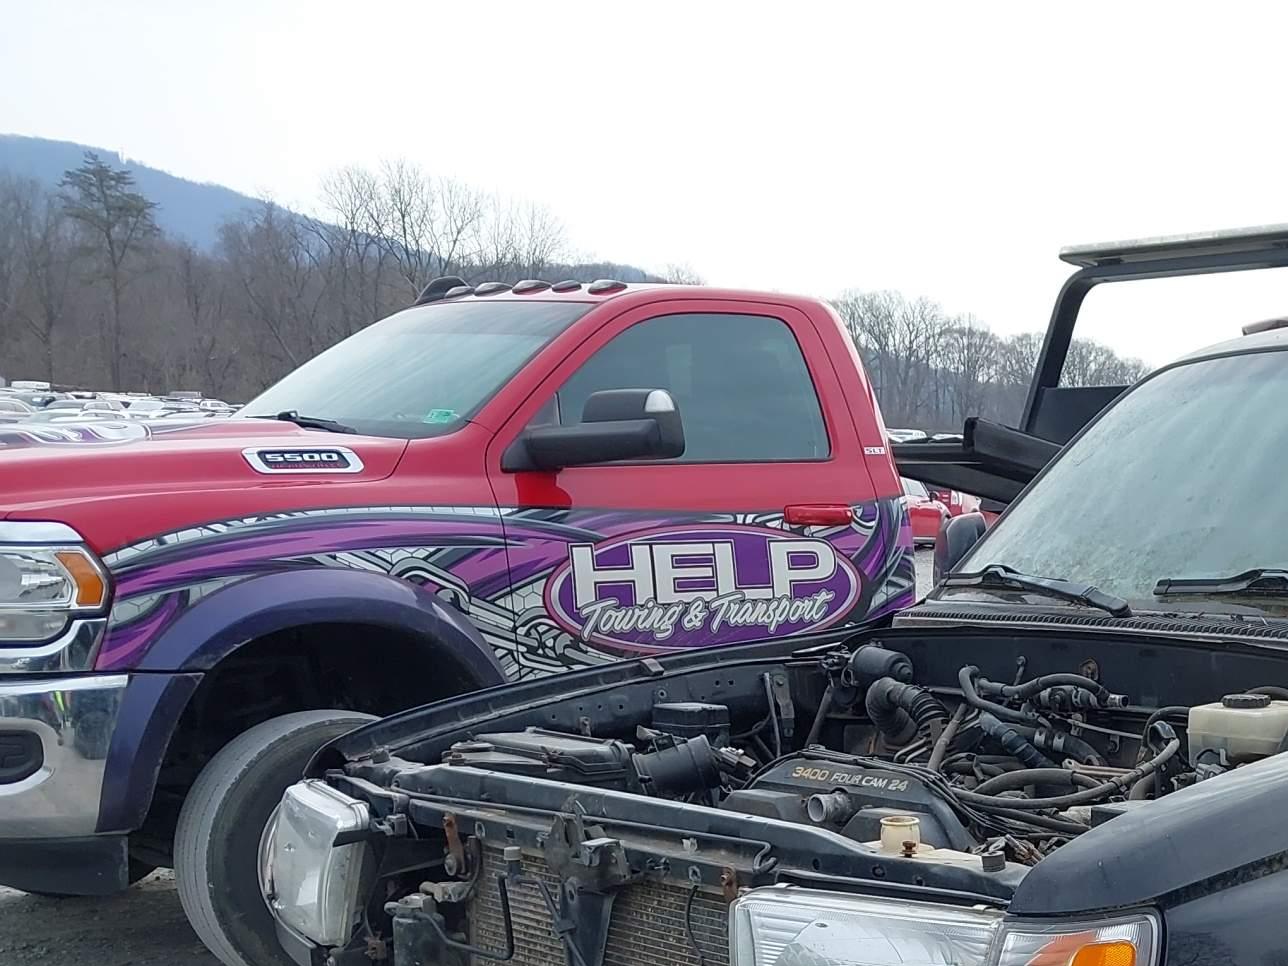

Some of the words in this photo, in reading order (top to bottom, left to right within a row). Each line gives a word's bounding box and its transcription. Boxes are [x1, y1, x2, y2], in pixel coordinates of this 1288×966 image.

[264, 453, 339, 462] 5500
[571, 539, 837, 609] HELP
[580, 597, 682, 640] Towing
[683, 597, 706, 631] &
[708, 590, 834, 633] Transport
[792, 766, 830, 781] 3400
[830, 772, 861, 785] FOUR
[861, 776, 888, 789] CAM
[887, 779, 909, 792] 24
